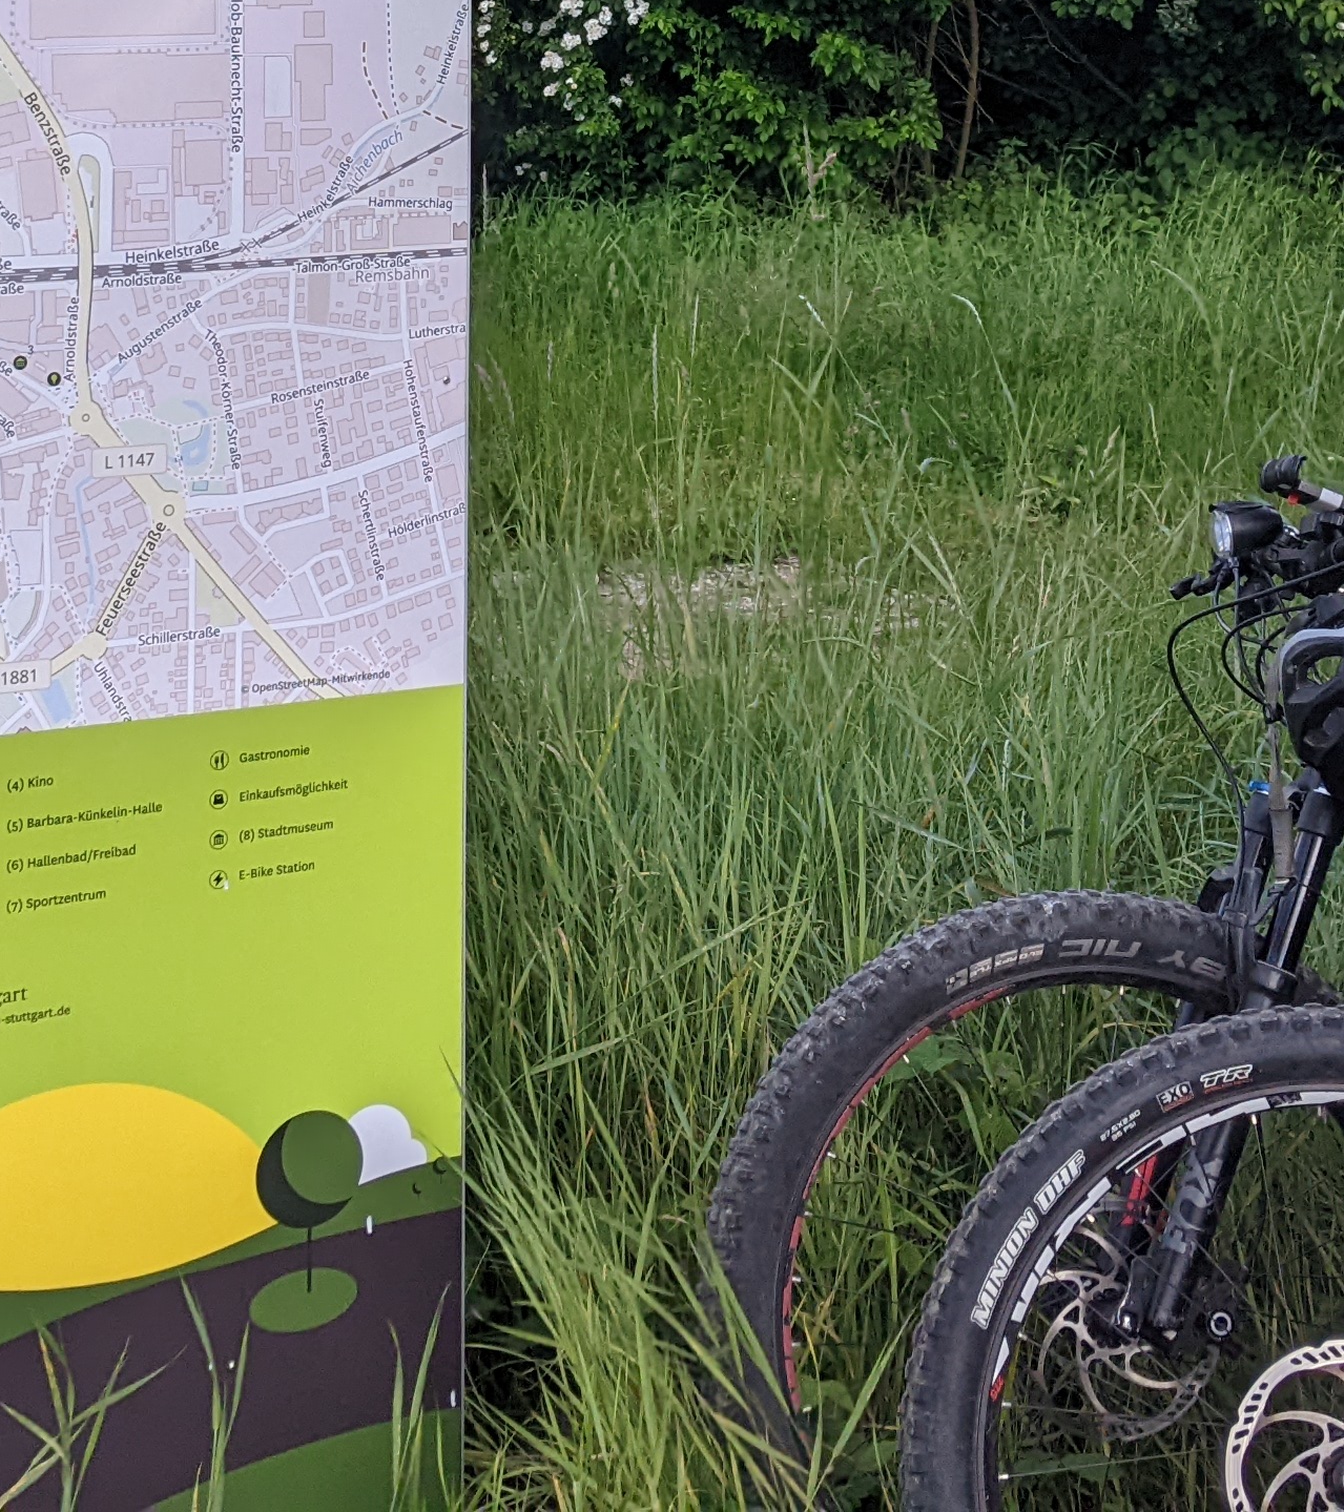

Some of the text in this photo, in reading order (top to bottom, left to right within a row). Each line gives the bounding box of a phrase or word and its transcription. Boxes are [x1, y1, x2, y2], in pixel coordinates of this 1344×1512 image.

[368, 195, 453, 212] Hammerschlag
[125, 239, 219, 264] Heinkelstraße
[271, 369, 370, 404] Rosensteinstraße
[104, 452, 155, 470] L 1147
[94, 521, 167, 638] Feuerseestraße
[138, 626, 221, 646] Schillerstraße
[0, 670, 38, 685] 1881
[239, 744, 310, 765] Gastronomie
[7, 775, 54, 794] (4) Kino
[239, 778, 349, 804] Einkaufsmöglichkeit
[7, 801, 163, 835] (5) Barbara-Künkelin-Halle
[239, 818, 334, 844] (8) Stadtmuseum
[7, 844, 136, 874] (6) Hallenbad/Freibad
[239, 860, 315, 881] E-Bike Station
[7, 887, 106, 914] (7) Sportzentrum
[1200, 1064, 1253, 1088] TR
[1158, 1082, 1191, 1108] EXO
[971, 1149, 1086, 1330] MINION DHF
